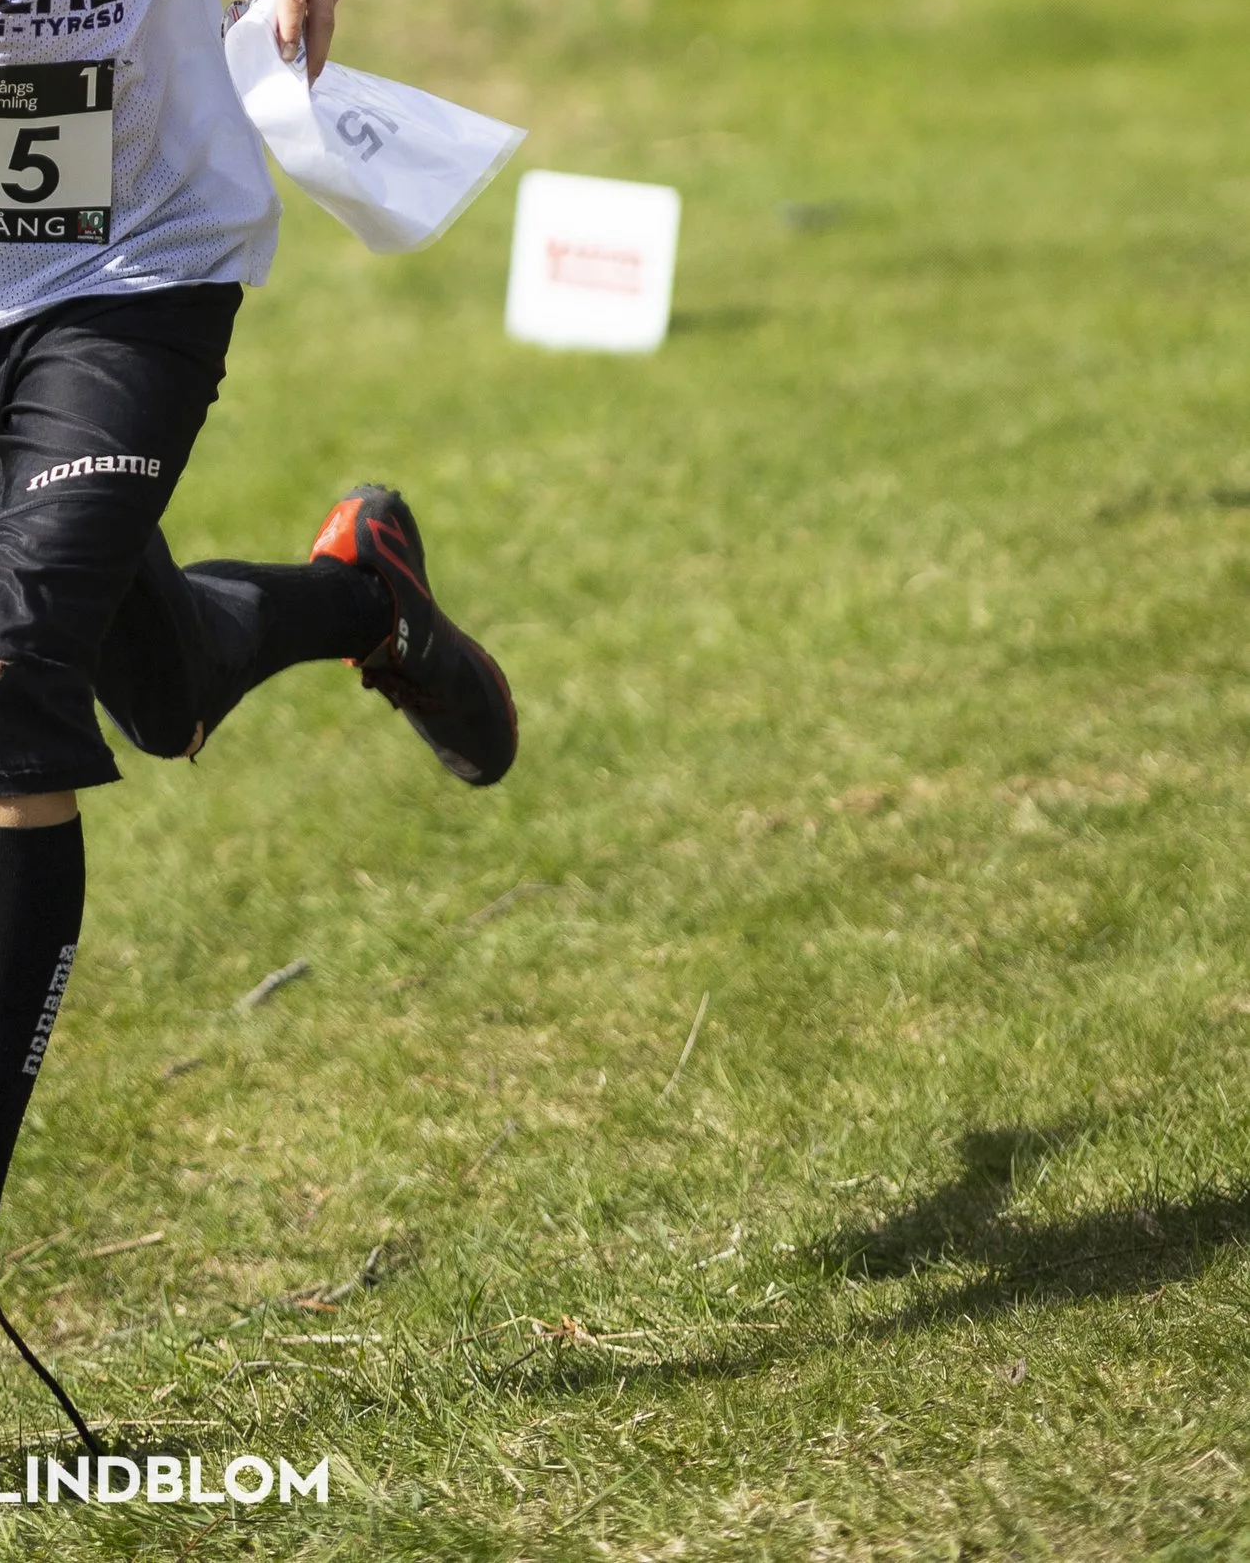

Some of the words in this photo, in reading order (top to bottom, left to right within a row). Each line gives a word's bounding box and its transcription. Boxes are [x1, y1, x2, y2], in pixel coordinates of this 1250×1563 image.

[79, 66, 98, 107] 1
[25, 454, 162, 492] noname
[21, 943, 79, 1076] noname
